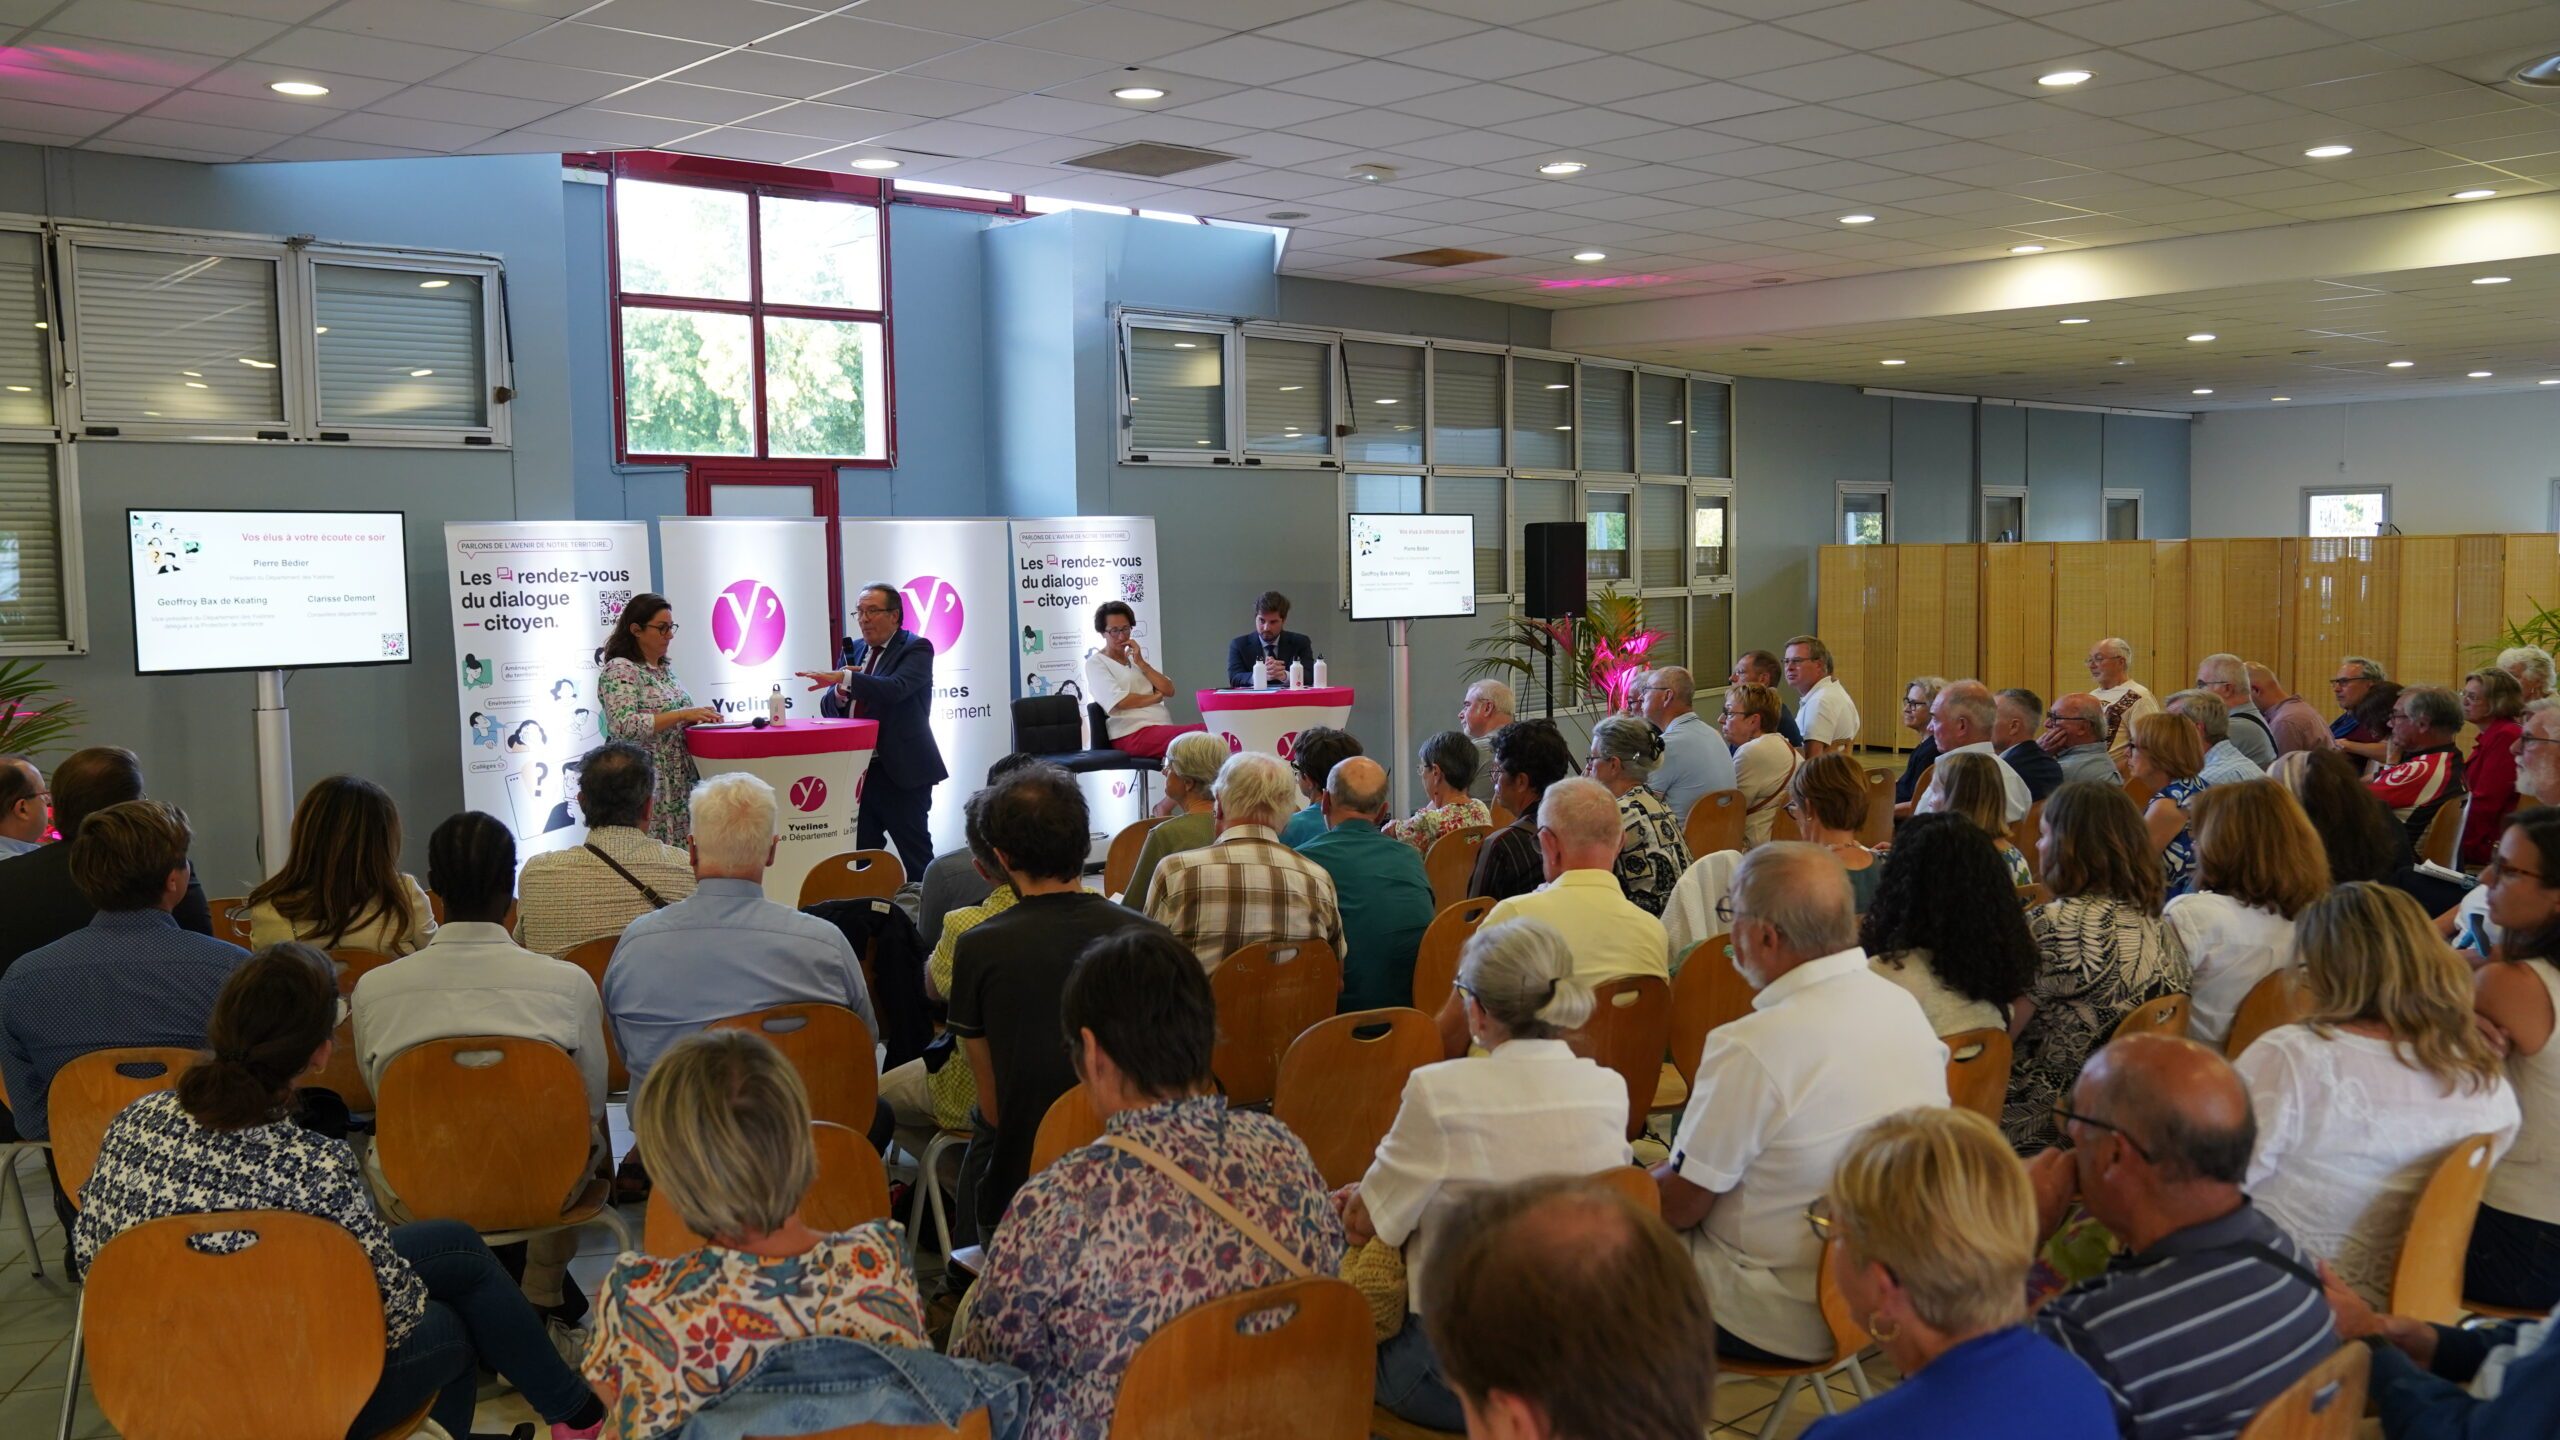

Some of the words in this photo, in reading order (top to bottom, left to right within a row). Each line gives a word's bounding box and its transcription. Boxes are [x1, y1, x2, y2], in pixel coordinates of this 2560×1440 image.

[241, 533, 260, 541] Vos
[263, 532, 284, 541] élus
[294, 533, 318, 541] votre
[321, 532, 353, 541] écoute
[368, 533, 386, 541] soir
[461, 542, 493, 550] PARLONS
[504, 541, 535, 549] L'AVENIR
[253, 559, 279, 567] Pierre
[1021, 557, 1043, 570] Les
[1061, 555, 1142, 569] rendez-vous
[460, 570, 492, 586] Les
[518, 568, 630, 584] rendez-vous
[1022, 575, 1038, 589] du
[1041, 574, 1099, 590] dialogue
[157, 598, 198, 607] Geoffroy
[200, 597, 218, 605] Bax
[220, 597, 231, 605] de
[234, 596, 268, 606] Keating
[343, 594, 376, 602] Demont
[461, 591, 485, 609] du
[490, 590, 570, 610] dialogue
[1038, 593, 1091, 609] citoyen.
[484, 614, 559, 633] citoyen.
[711, 696, 794, 713] Yvelins
[788, 822, 829, 831] Yvelines
[789, 830, 838, 842] Département
